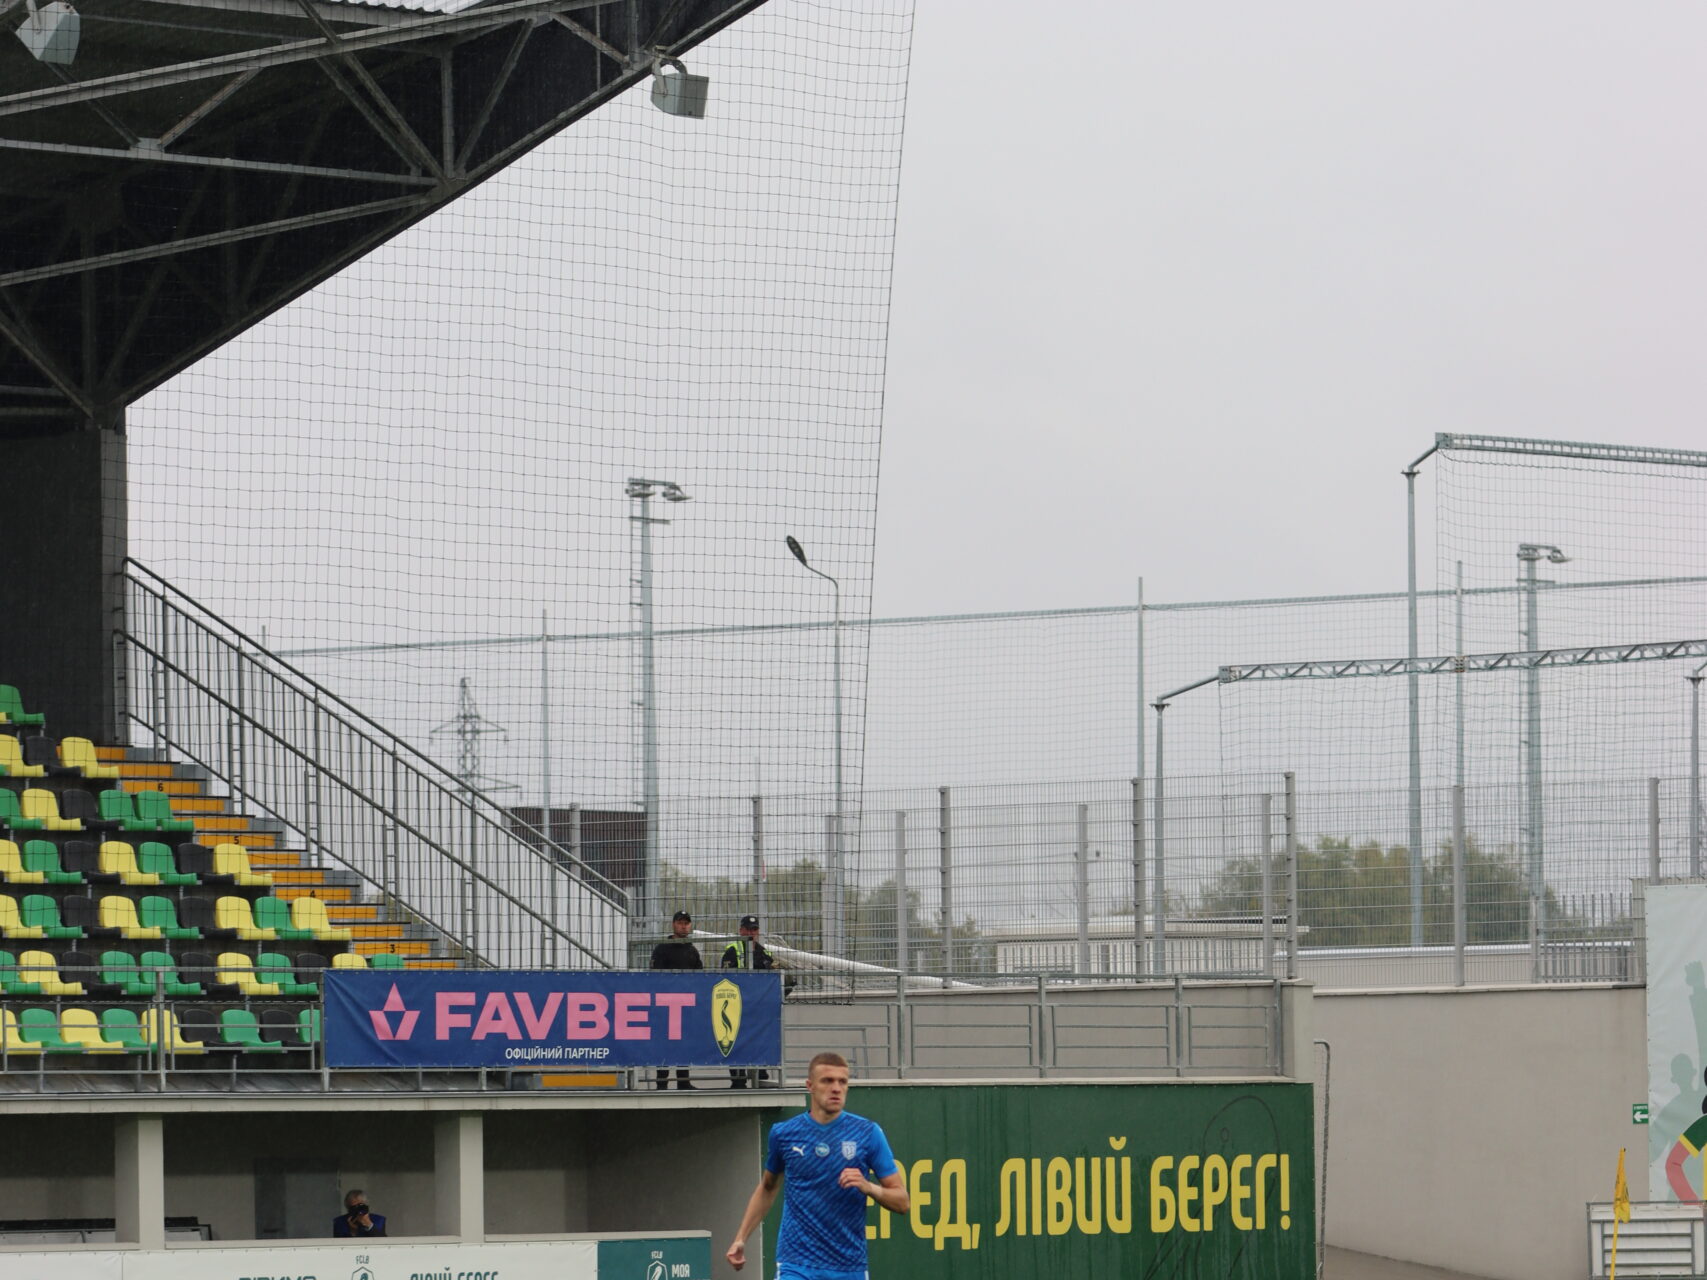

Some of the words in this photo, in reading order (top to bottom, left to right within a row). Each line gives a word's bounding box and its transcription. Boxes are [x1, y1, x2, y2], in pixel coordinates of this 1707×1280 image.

[435, 992, 696, 1041] FAVBET
[505, 1046, 563, 1060] ОФІЦІЙНИЙ
[564, 1047, 610, 1059] ПАРТНЕР
[996, 1136, 1132, 1236] ЛІВИЙ
[1150, 1153, 1291, 1234] БЕРЕГ!
[671, 1264, 690, 1278] МОЯ
